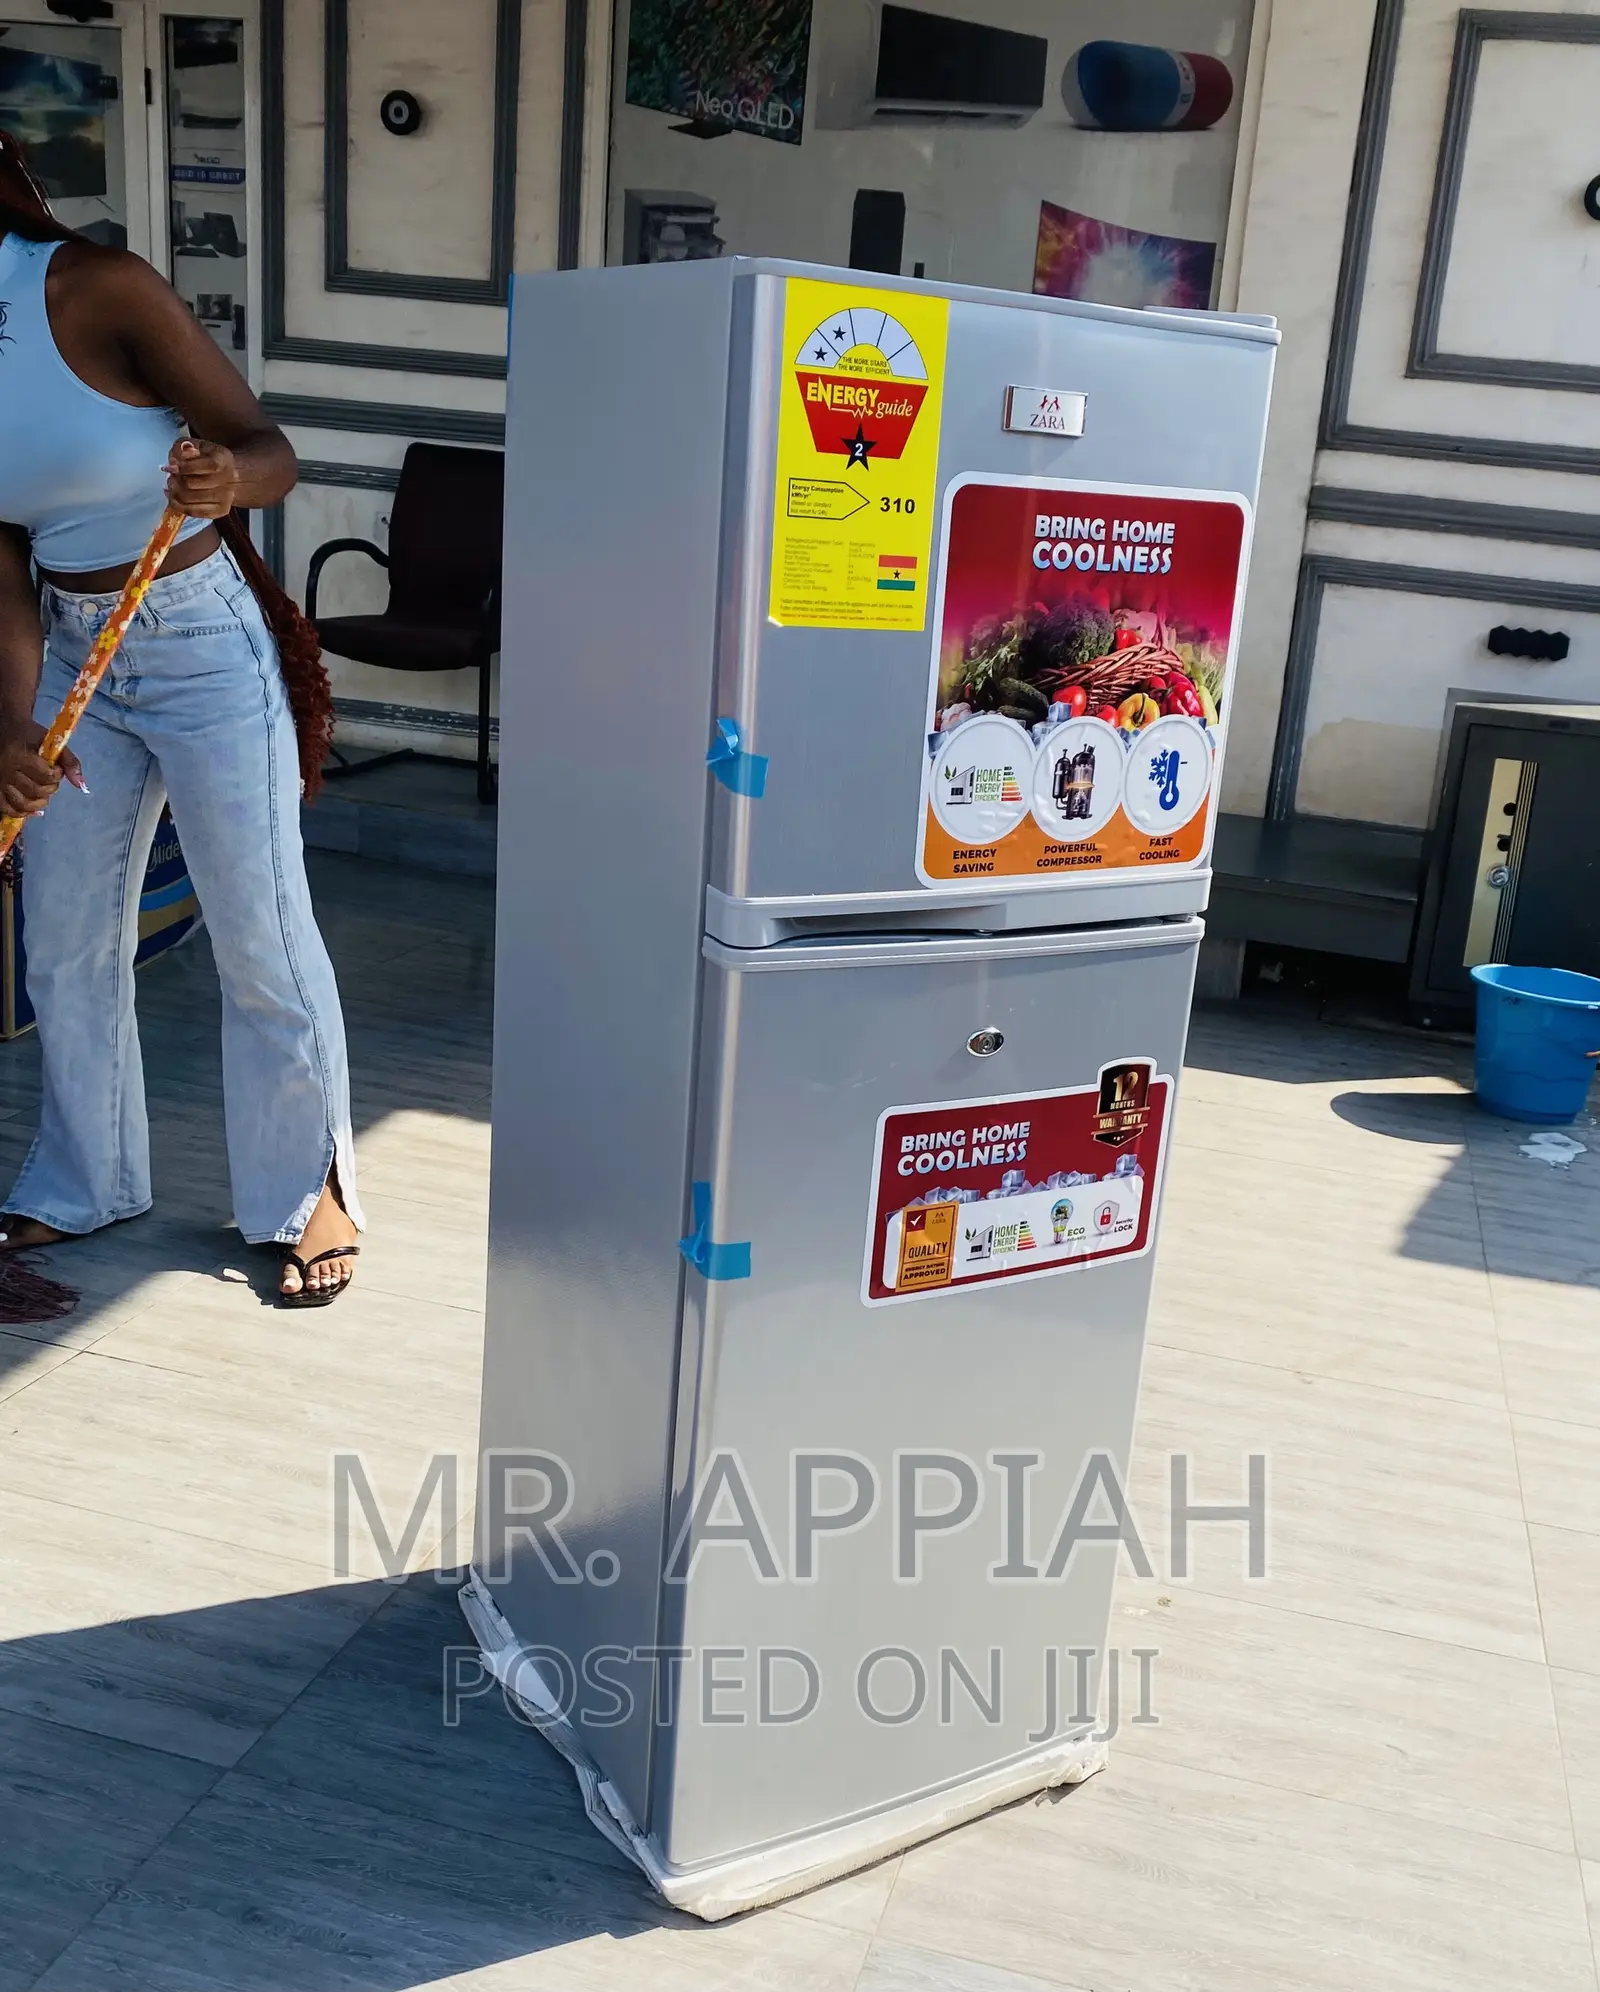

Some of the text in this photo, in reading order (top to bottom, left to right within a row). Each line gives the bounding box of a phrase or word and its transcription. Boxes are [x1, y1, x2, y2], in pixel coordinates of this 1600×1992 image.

[695, 90, 794, 129] Neo QLED
[843, 356, 887, 368] THE MORE STARS
[838, 363, 890, 375] THE MORE EFFICIENT
[806, 376, 914, 418] ENERGY guide
[1029, 413, 1066, 430] ZARA
[854, 443, 863, 456] 2
[791, 484, 810, 492] Energy
[880, 497, 916, 514] 310
[1034, 515, 1176, 545] BRING HOME
[1032, 541, 1173, 575] COOLNESS
[976, 769, 1002, 782] HOME
[975, 783, 1001, 793] ENERGY
[1149, 837, 1173, 847] FAST
[953, 849, 997, 859] ENERGY
[1044, 843, 1098, 854] POWERFUL
[1139, 849, 1180, 860] COOLING
[147, 840, 181, 872] Mide
[1036, 855, 1102, 867] COMPRESSOR
[953, 863, 994, 873] SAVING
[1113, 1072, 1138, 1101] 12
[1110, 1100, 1135, 1110] MONTHS
[901, 1122, 1030, 1153] BRING HOME
[898, 1140, 1027, 1176] COOLNESS
[995, 1224, 1018, 1238] HOME
[1067, 1227, 1085, 1236] ECO
[1114, 1224, 1133, 1233] LOCK
[993, 1236, 1016, 1247] ENERGY
[908, 1241, 948, 1259] QUALITY
[903, 1268, 946, 1280] APPROVED
